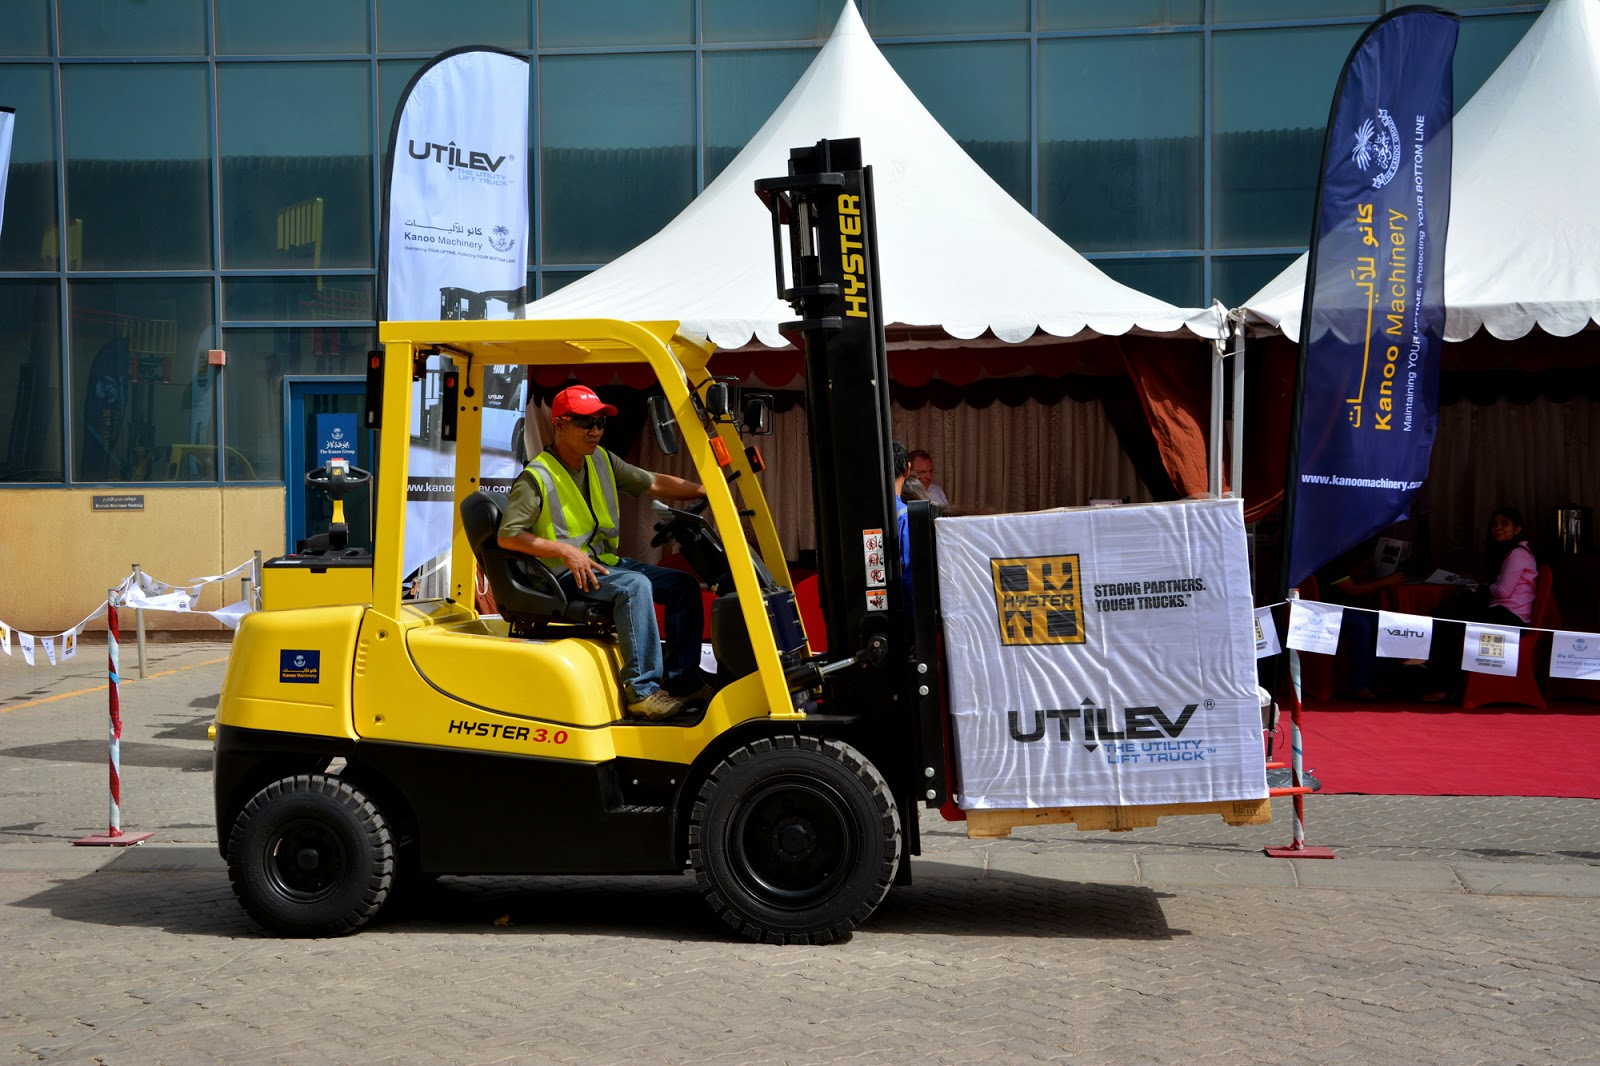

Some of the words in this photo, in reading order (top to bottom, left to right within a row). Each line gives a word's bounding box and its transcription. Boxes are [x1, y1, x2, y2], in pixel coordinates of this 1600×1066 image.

[1415, 115, 1425, 137] LINE
[457, 168, 473, 176] THE
[475, 171, 507, 180] UTILITY
[1414, 145, 1425, 193] BOTTOM
[1416, 195, 1425, 227] YOUR
[1357, 203, 1379, 247] كانو
[404, 231, 435, 244] Kanoo
[438, 236, 483, 251] Machinery
[457, 251, 477, 259] Protecting
[489, 255, 506, 263] BOTTOM
[837, 193, 869, 318] HYSTER
[1416, 231, 1426, 283] Protecting
[1386, 209, 1408, 335] Machinery
[1408, 336, 1421, 369] YOUR
[1374, 345, 1399, 431] Kanoo
[1403, 371, 1417, 431] Maintaining
[1094, 580, 1142, 598] STRONG
[1143, 577, 1206, 595] PARTNERS.
[1002, 593, 1076, 609] HYSTER
[1095, 596, 1136, 612] TOUGH
[448, 719, 530, 741] HYSTER
[532, 728, 568, 744] 3.0
[1103, 742, 1136, 753] THE
[1141, 739, 1204, 751] UTILITY
[1107, 753, 1141, 765] LIFT
